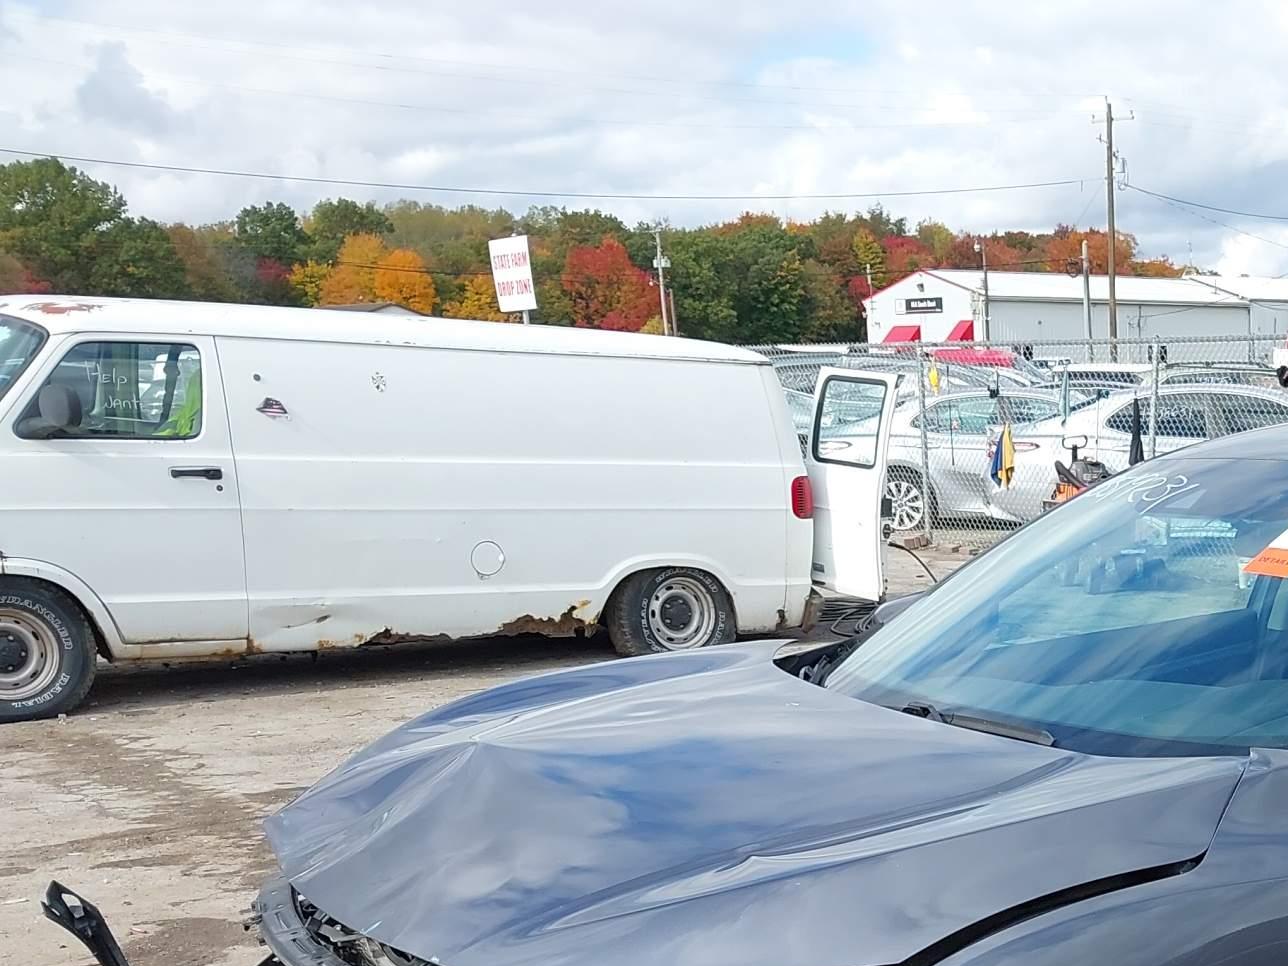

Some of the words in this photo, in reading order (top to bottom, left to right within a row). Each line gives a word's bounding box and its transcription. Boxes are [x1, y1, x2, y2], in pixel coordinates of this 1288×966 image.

[493, 254, 510, 270] STATE
[511, 251, 529, 268] FARM
[497, 281, 514, 297] DROP
[516, 278, 532, 294] ZONE
